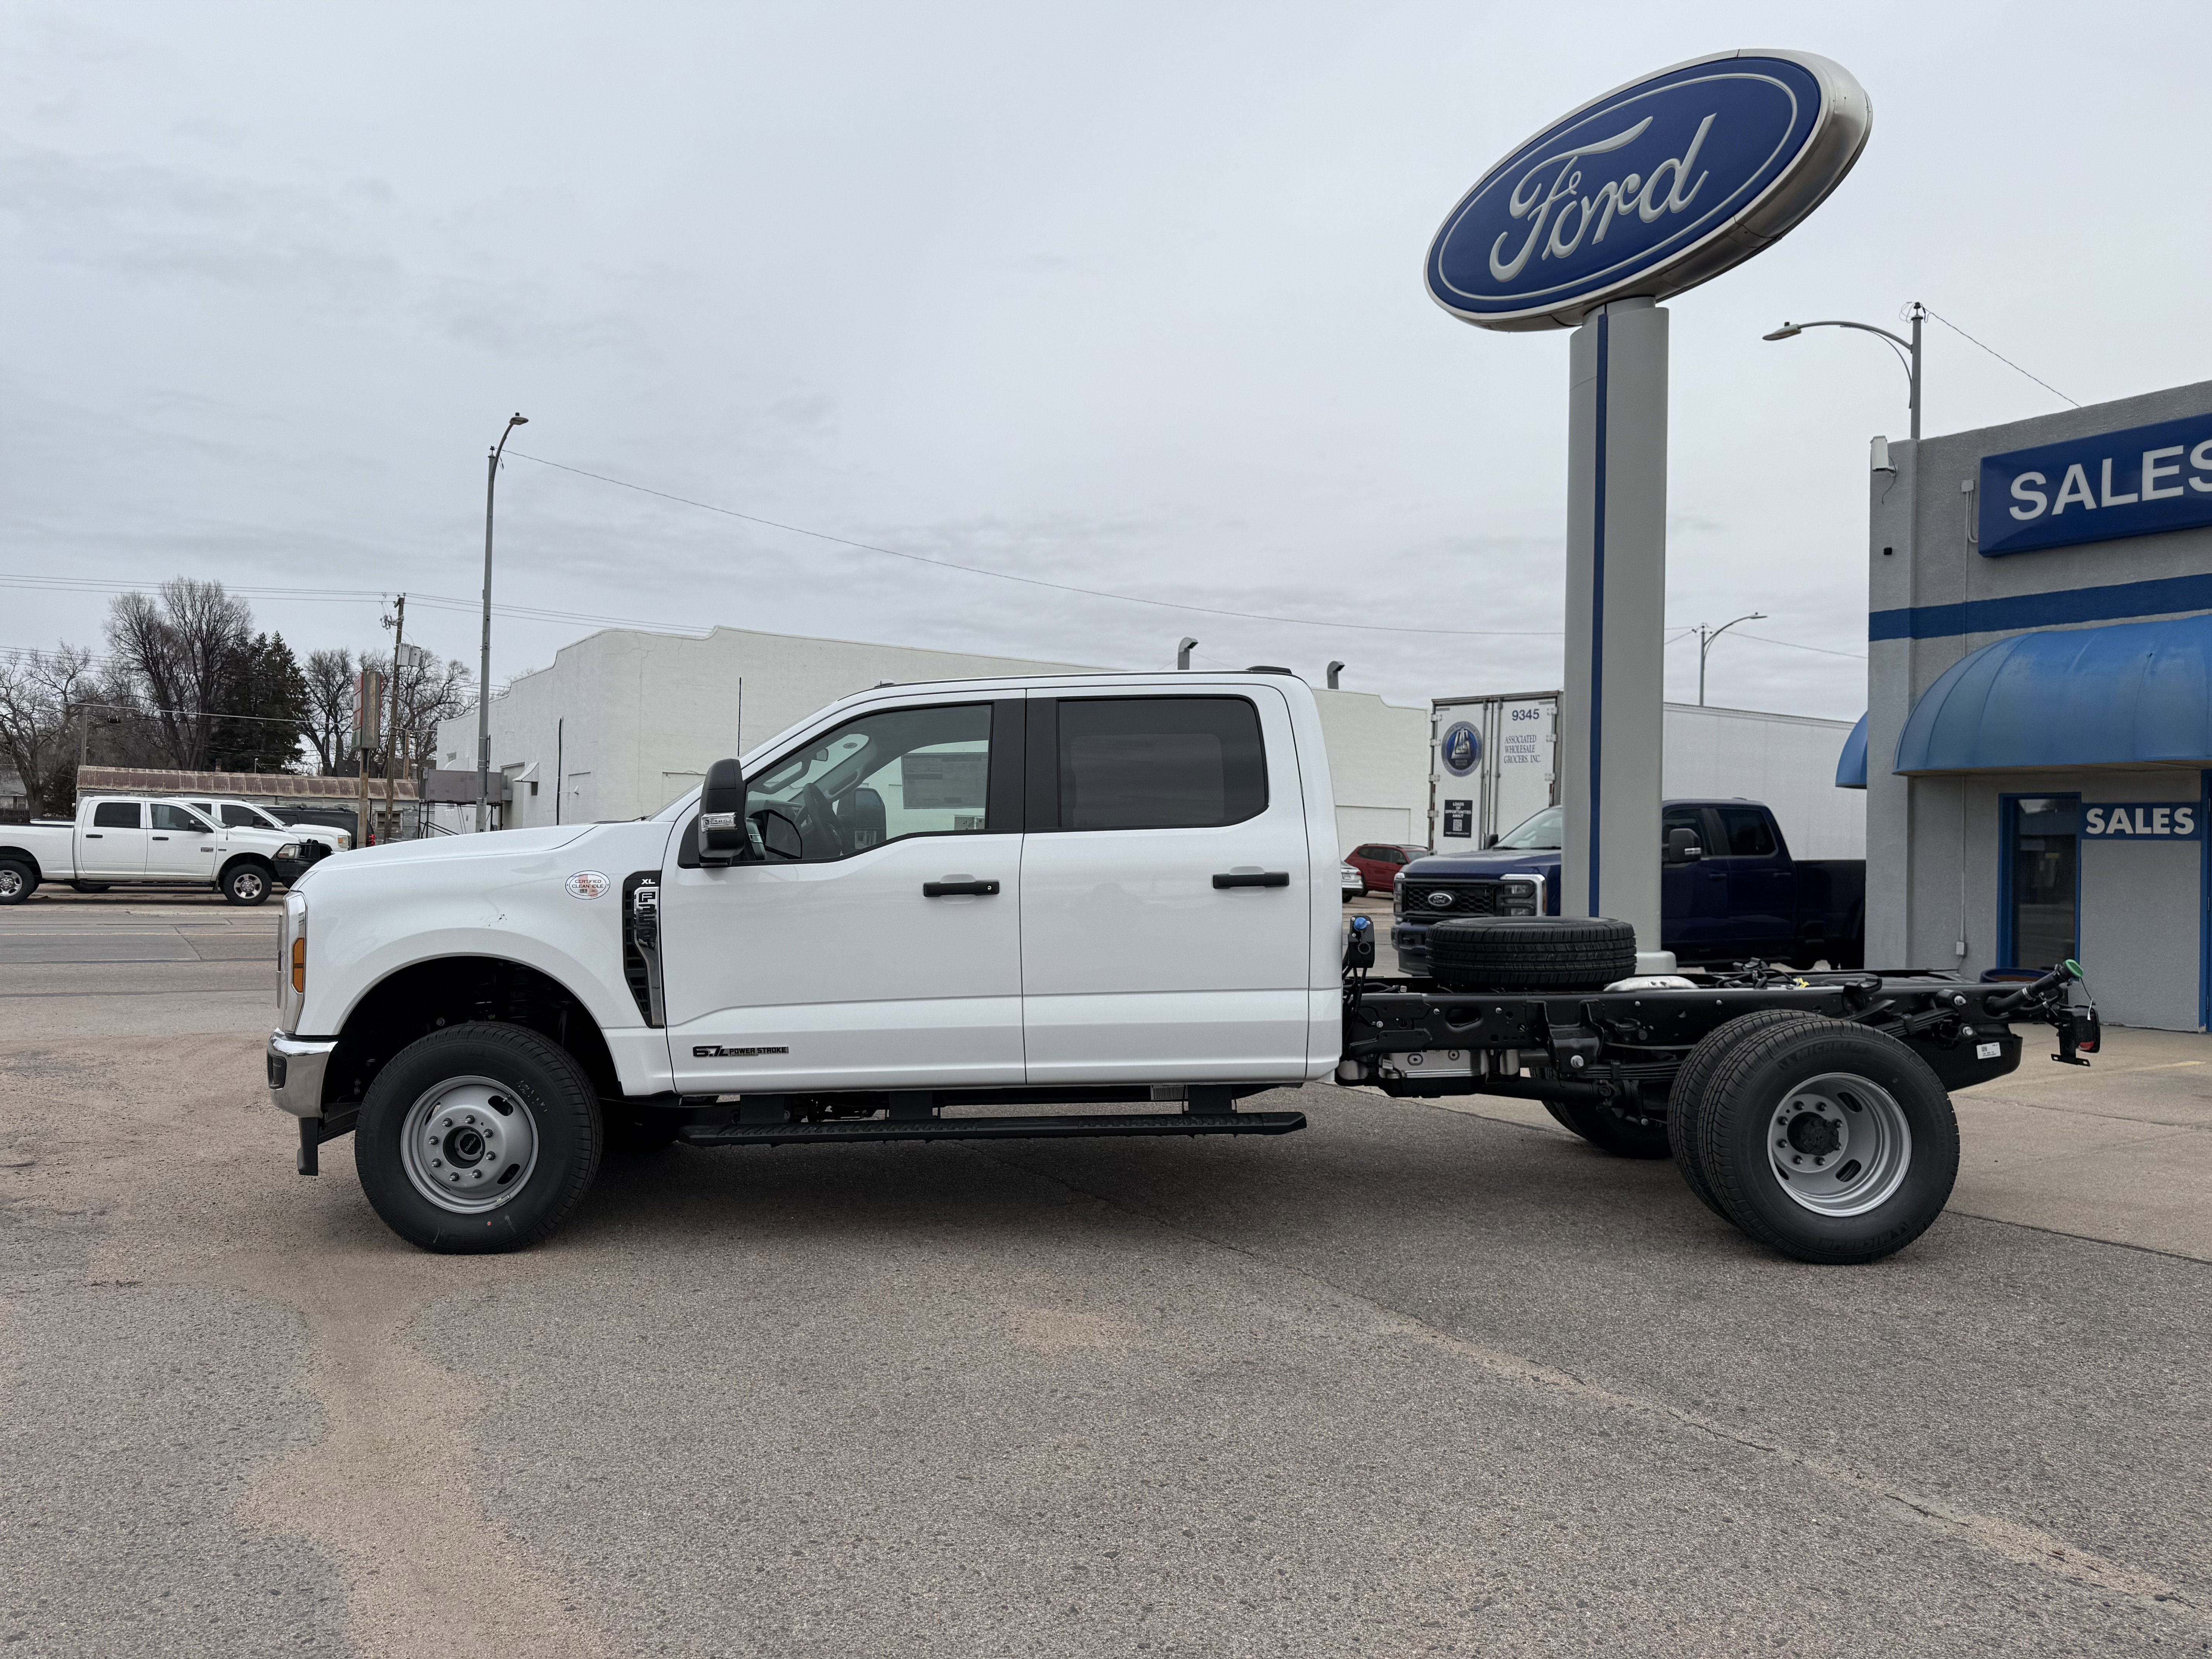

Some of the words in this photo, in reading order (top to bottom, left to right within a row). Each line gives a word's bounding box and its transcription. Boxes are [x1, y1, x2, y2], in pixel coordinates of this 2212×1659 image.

[1489, 112, 1717, 282] Ford
[1512, 709, 1539, 721] 9345
[1505, 735, 1536, 744] ASSOCIATED
[1505, 744, 1535, 753] WHOLESALE
[2086, 808, 2195, 835] SALES
